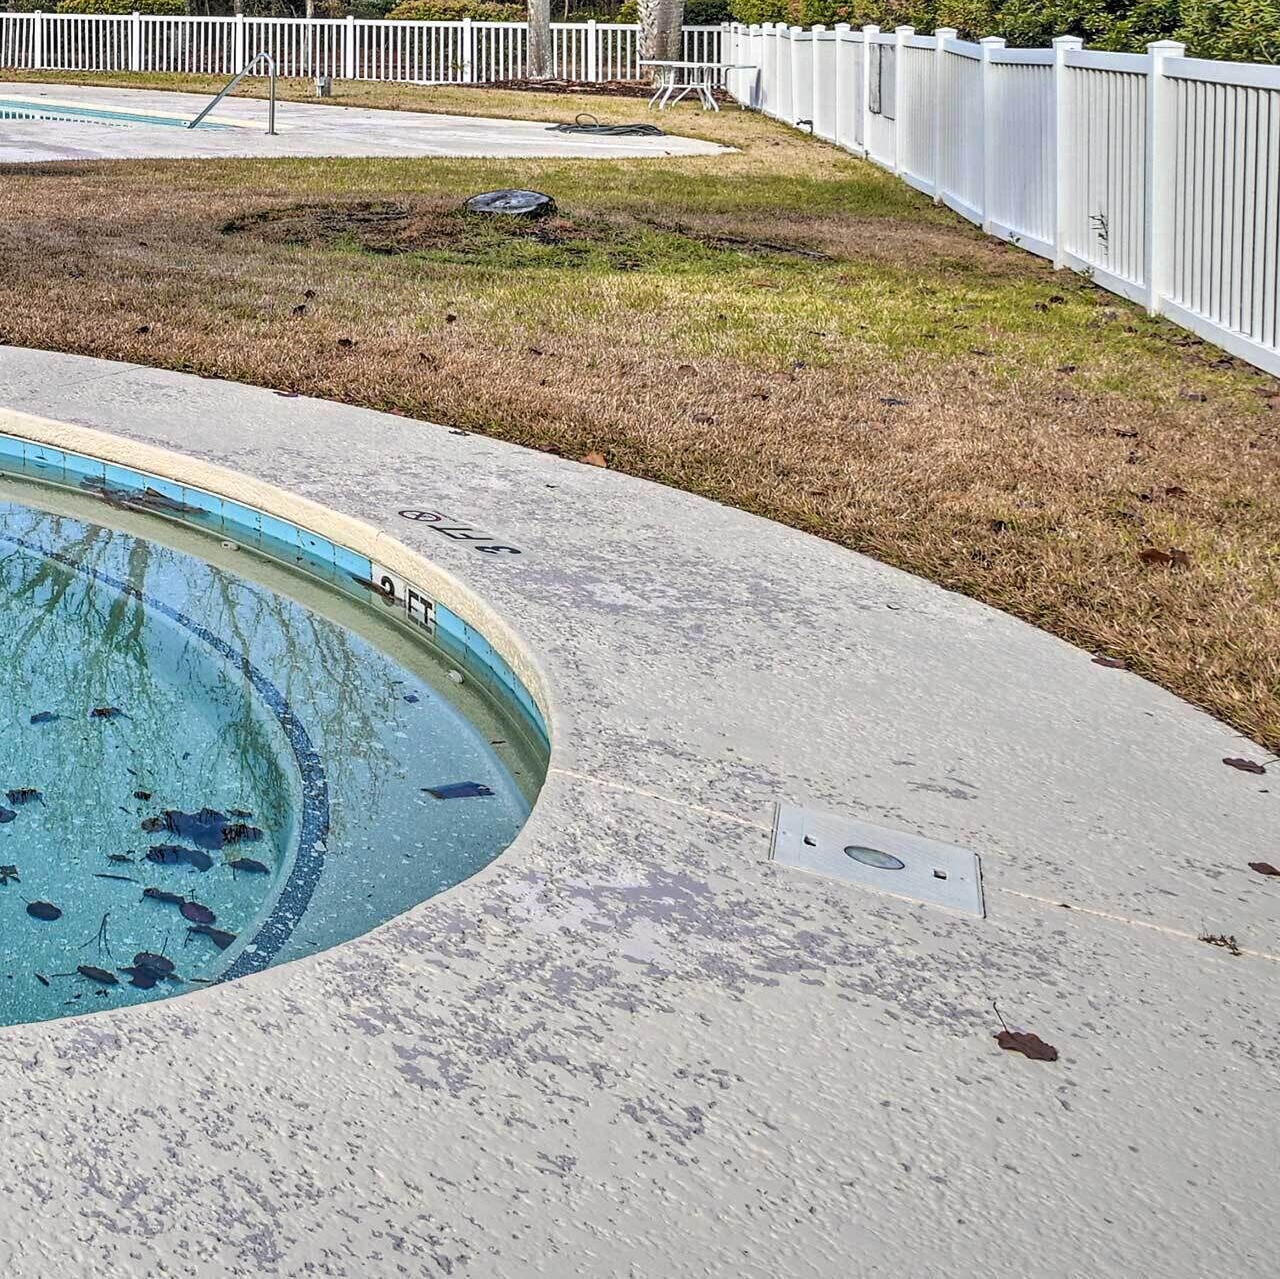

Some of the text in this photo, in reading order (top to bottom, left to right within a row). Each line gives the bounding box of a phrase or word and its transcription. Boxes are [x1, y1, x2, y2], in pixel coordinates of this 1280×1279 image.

[427, 525, 521, 554] 3 FT
[408, 588, 433, 625] FT
